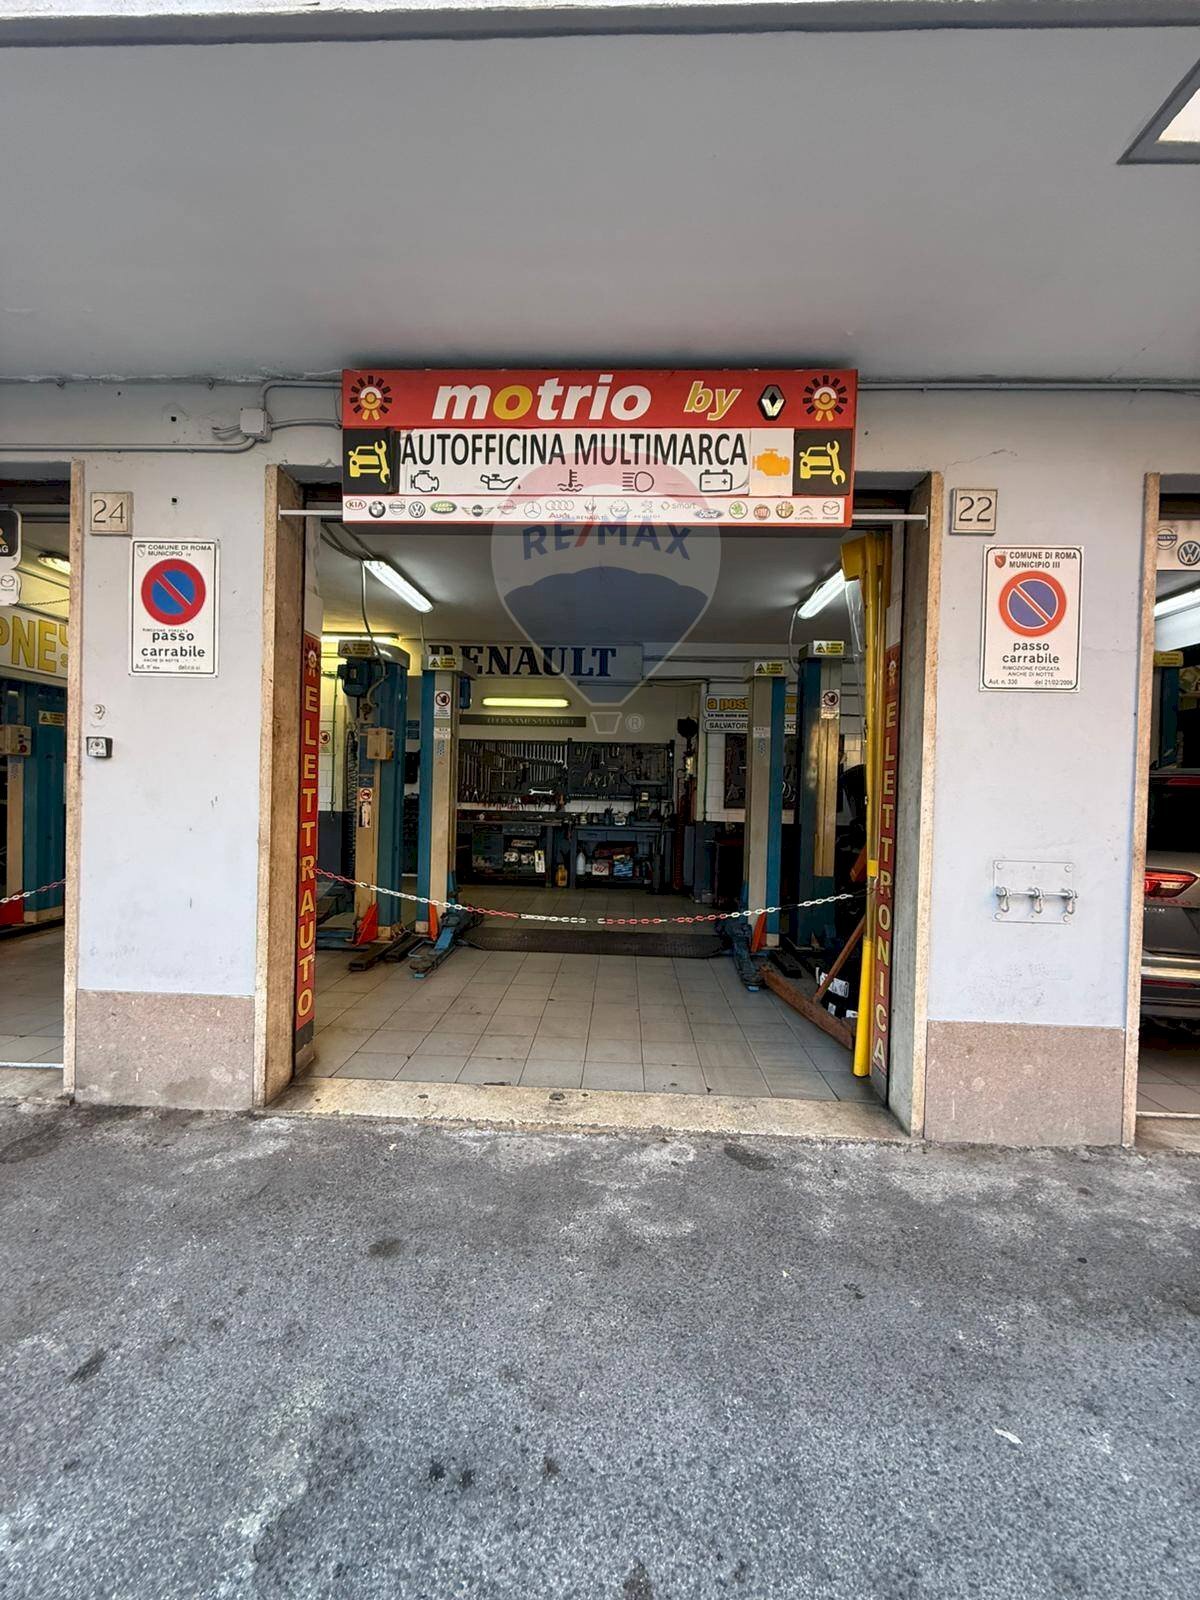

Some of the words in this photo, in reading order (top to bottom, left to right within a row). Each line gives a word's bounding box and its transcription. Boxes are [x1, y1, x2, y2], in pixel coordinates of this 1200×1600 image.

[432, 374, 652, 421] motrio
[683, 380, 742, 422] by
[401, 432, 565, 466] AUTOFFICINA
[574, 432, 749, 466] MULTIMARCA
[93, 499, 126, 524] 24
[671, 502, 697, 510] smart
[958, 496, 992, 523] 22
[1009, 551, 1043, 560] COMUNE
[1044, 551, 1053, 560] DI
[1054, 551, 1078, 560] ROMA
[1009, 561, 1050, 569] MUNICIPIO
[1052, 561, 1061, 569] III
[152, 632, 194, 643] passo
[141, 645, 206, 657] carrabile
[1013, 642, 1050, 652] passo
[1002, 653, 1060, 664] carrabile
[297, 684, 318, 1018] ELETTRAUTO
[872, 703, 897, 1067] ELETTRONICA
